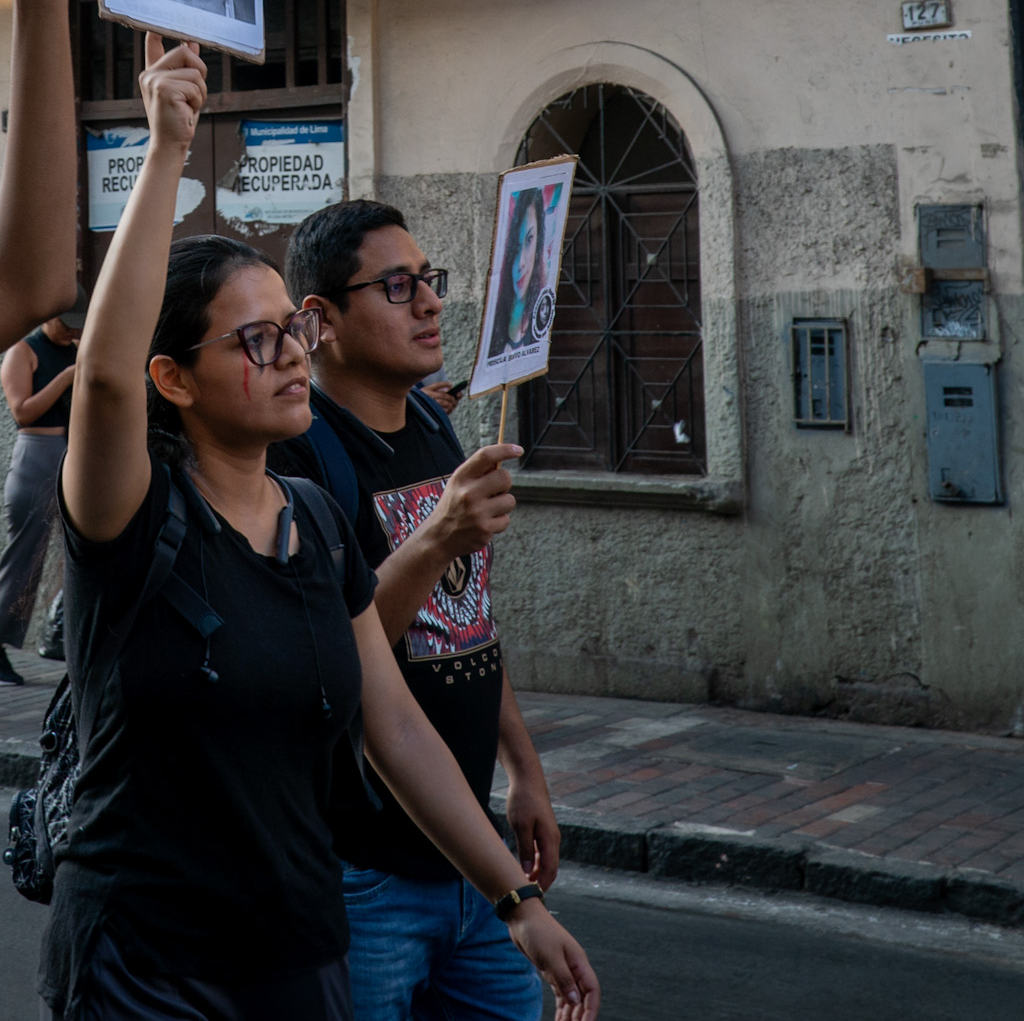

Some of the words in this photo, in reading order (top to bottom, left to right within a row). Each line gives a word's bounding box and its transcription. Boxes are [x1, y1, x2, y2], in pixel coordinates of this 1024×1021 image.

[908, 2, 939, 21] 127
[250, 125, 298, 137] Municipalidad
[299, 125, 309, 134] de
[309, 124, 328, 134] Lima
[108, 156, 144, 175] PROP
[239, 155, 324, 173] PROPIEDAD
[102, 175, 136, 193] RECU
[241, 173, 333, 192] ECUPERADA
